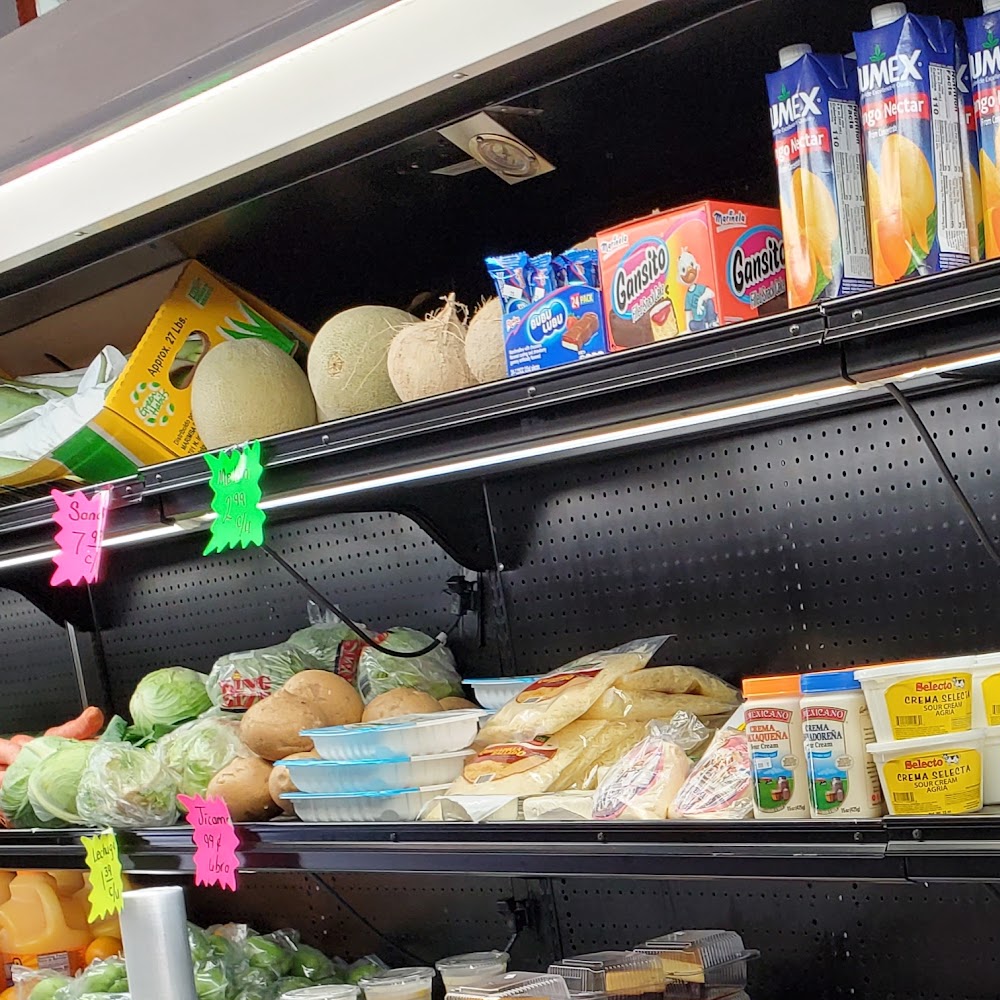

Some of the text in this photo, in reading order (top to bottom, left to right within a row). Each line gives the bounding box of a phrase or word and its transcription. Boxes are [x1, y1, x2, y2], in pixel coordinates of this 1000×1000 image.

[857, 49, 922, 93] UMEX
[769, 86, 822, 131] UMEX
[884, 98, 924, 118] Nectar
[790, 133, 824, 154] Nectar
[714, 210, 746, 225] Marinela
[601, 234, 629, 250] Marinela
[616, 245, 666, 312] Gansito
[571, 293, 594, 308] 24 PACK
[530, 308, 552, 331] BUBU
[542, 314, 563, 333] LUBU
[148, 316, 188, 378] Approx. 27 Lbs.
[915, 681, 952, 692] Selecto
[904, 690, 971, 705] CREMA SELECTA
[923, 701, 963, 712] SOUR CREAM
[935, 709, 955, 717] AGRIA
[904, 758, 944, 770] Selecto
[897, 764, 971, 782] CREMA SELECTA
[914, 777, 958, 789] SOUR CREAM
[926, 785, 949, 793] AGRIA
